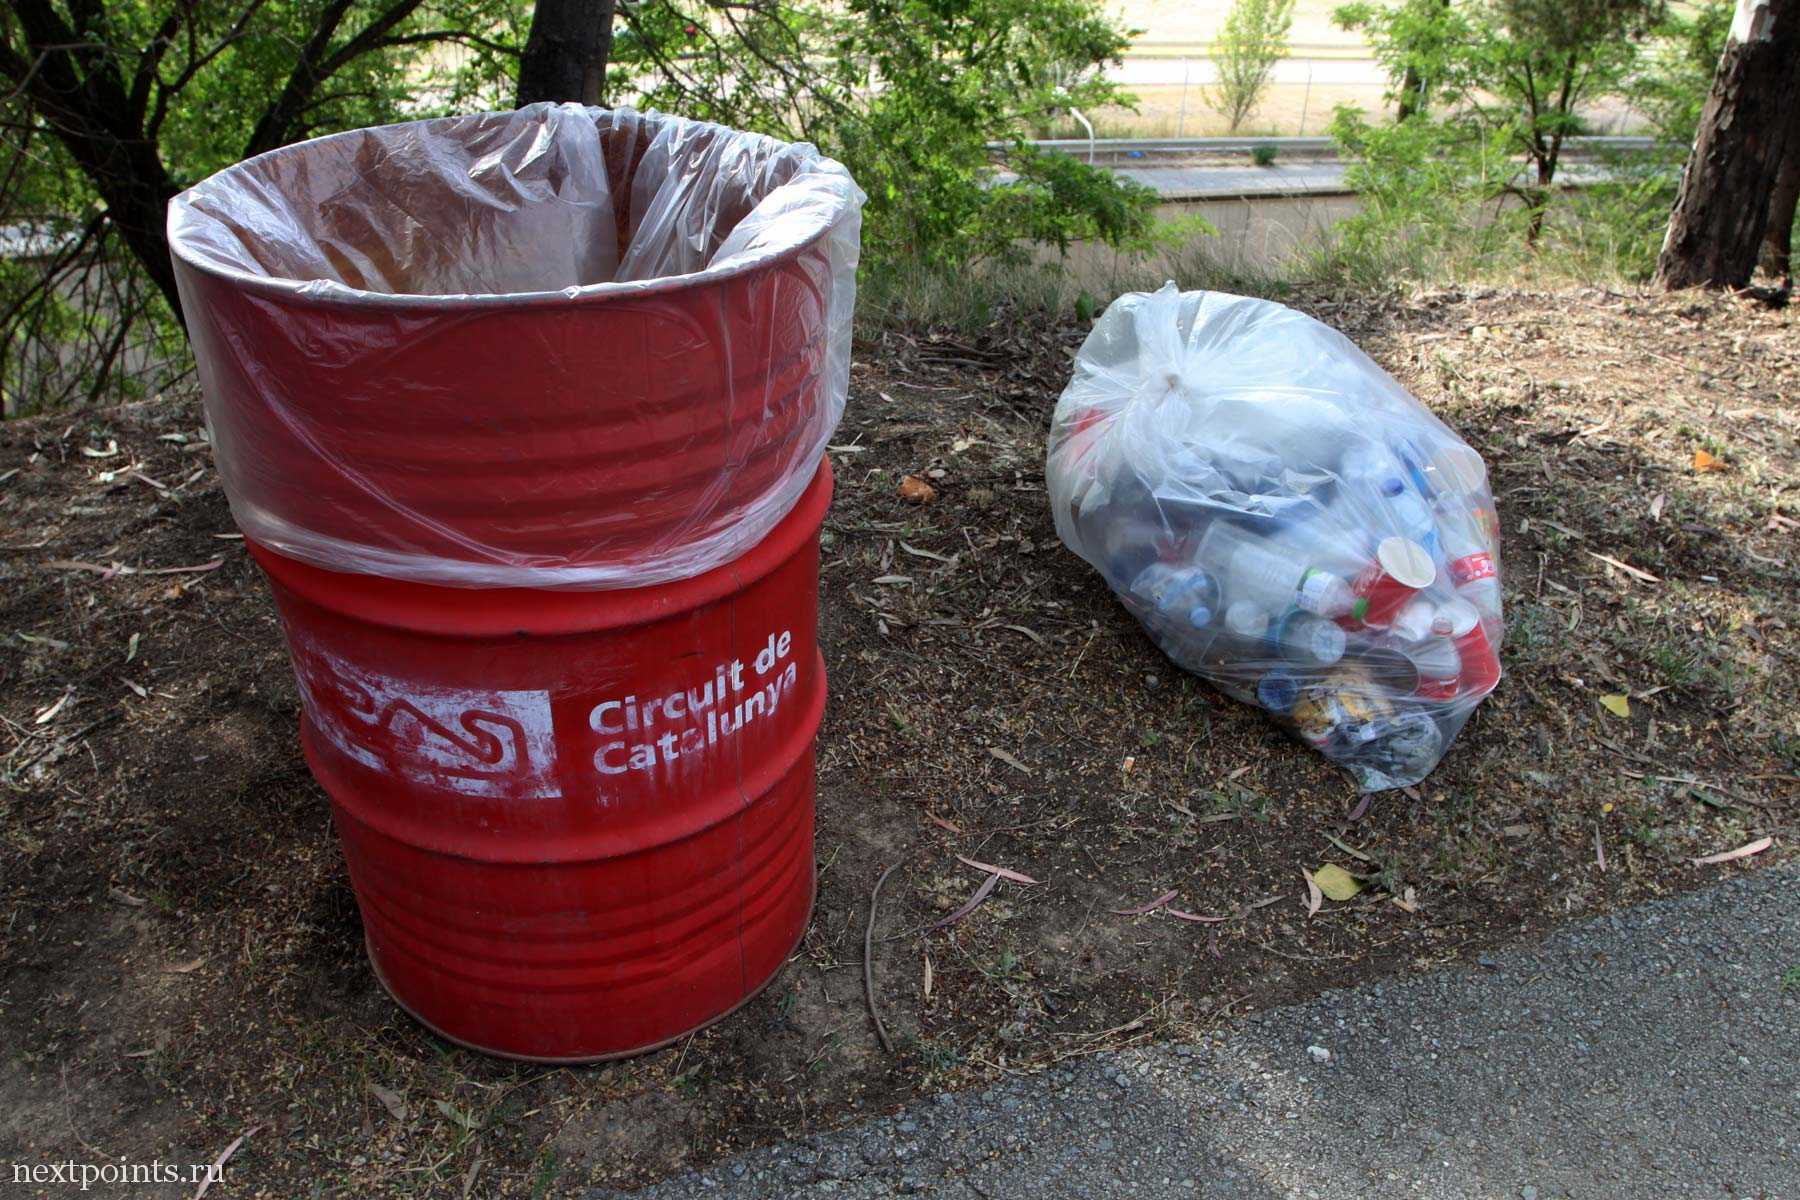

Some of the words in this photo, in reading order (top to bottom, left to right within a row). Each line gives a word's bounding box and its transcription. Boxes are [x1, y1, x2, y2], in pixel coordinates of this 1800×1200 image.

[589, 658, 744, 736] Circuit
[753, 630, 791, 675] de
[593, 661, 796, 774] Catalunya
